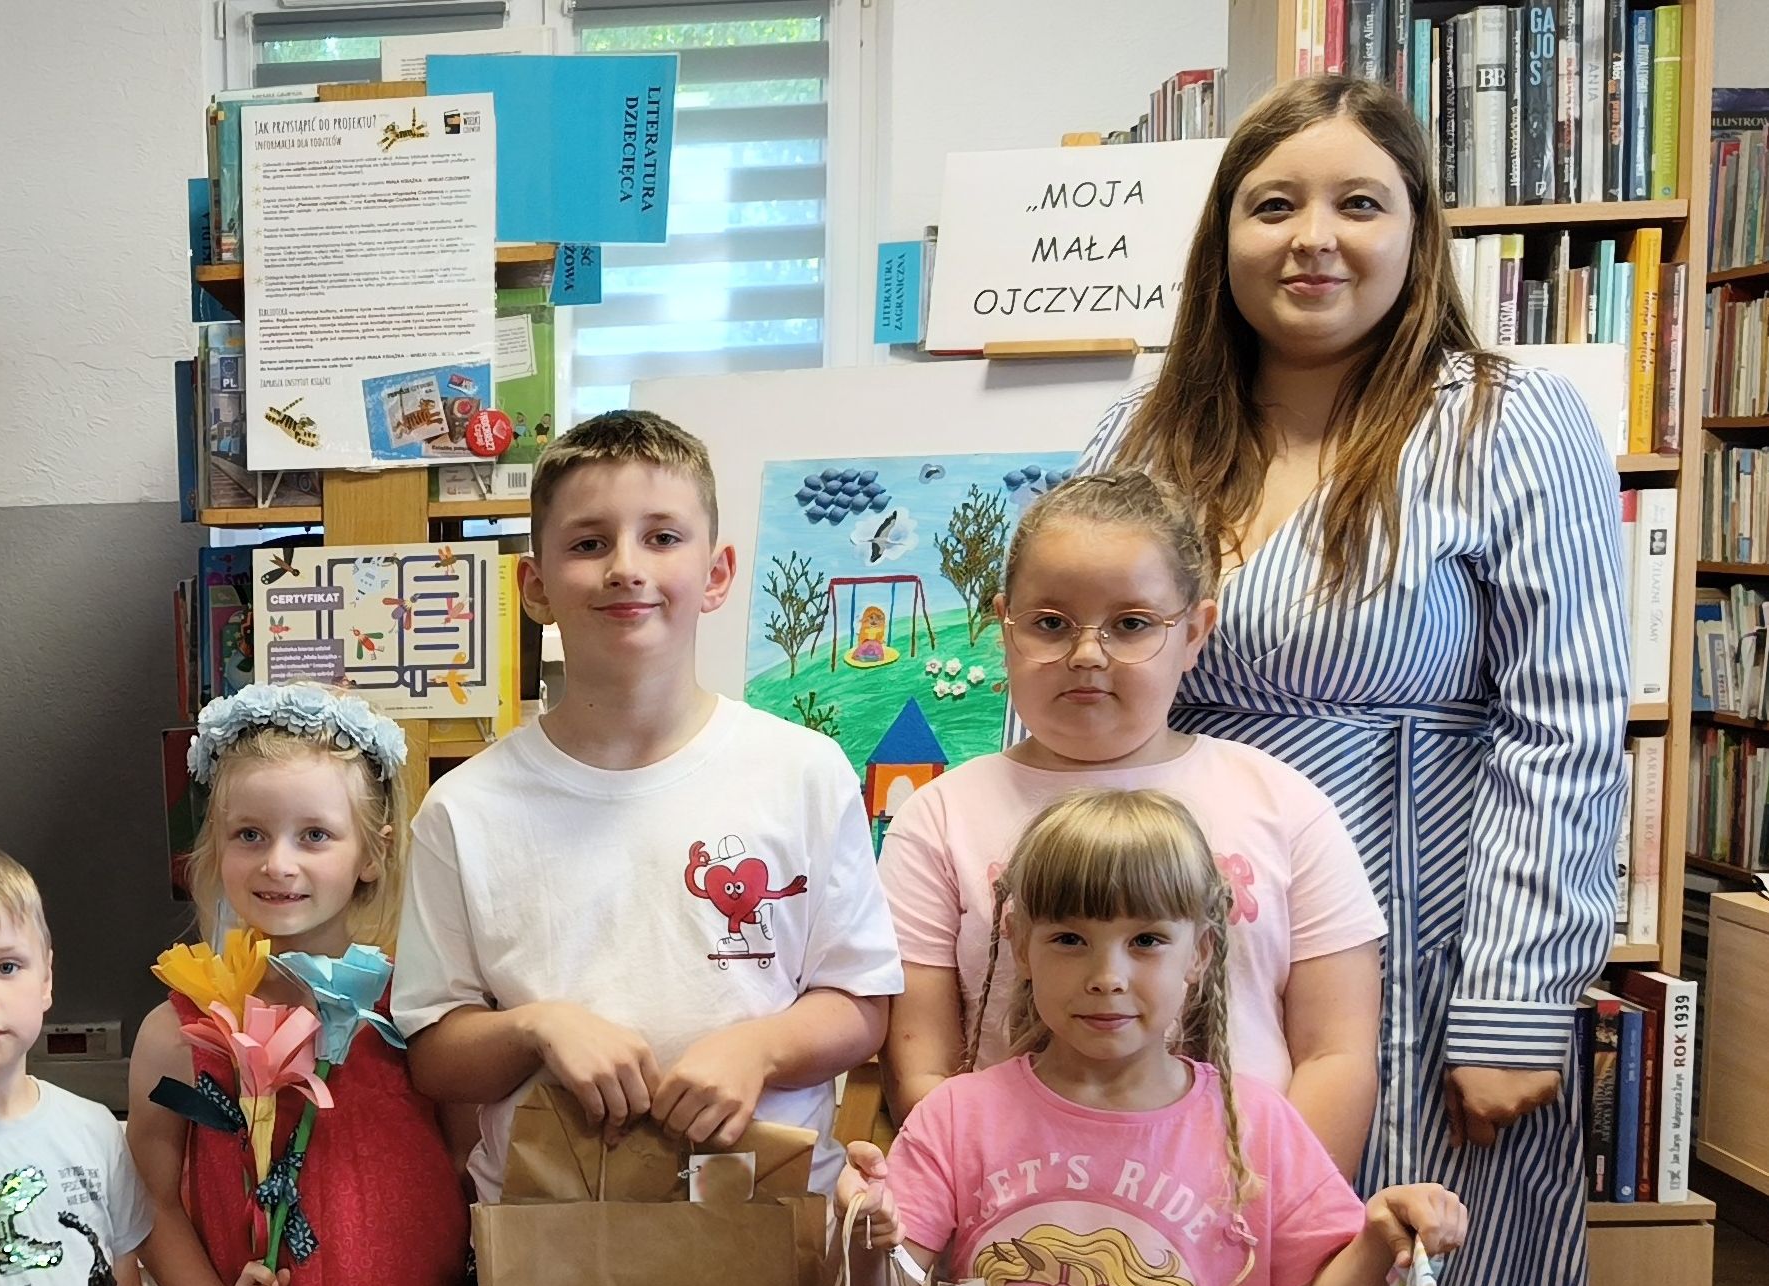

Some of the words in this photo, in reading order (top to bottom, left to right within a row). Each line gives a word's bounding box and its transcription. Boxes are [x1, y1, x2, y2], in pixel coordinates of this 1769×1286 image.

[1478, 67, 1506, 88] BB
[1588, 63, 1600, 102] ANIA
[254, 119, 271, 136] JAK
[272, 116, 316, 135] PRZYSTĄPIĆ
[318, 117, 331, 131] DO
[333, 113, 377, 131] PROJEKTU?
[618, 96, 639, 203] DZIECIĘCA
[641, 86, 661, 212] LITERATURA
[1025, 179, 1145, 214] „MOJA
[1031, 234, 1130, 263] MAŁA
[882, 259, 894, 327] LITERATURA
[894, 252, 907, 331] ZAGRANICZNA
[222, 377, 238, 389] PL
[270, 592, 340, 605] CERTYFIKAT
[1674, 995, 1690, 1029] 1939
[1673, 1033, 1688, 1068] ROK
[1112, 1158, 1219, 1244] RIDE
